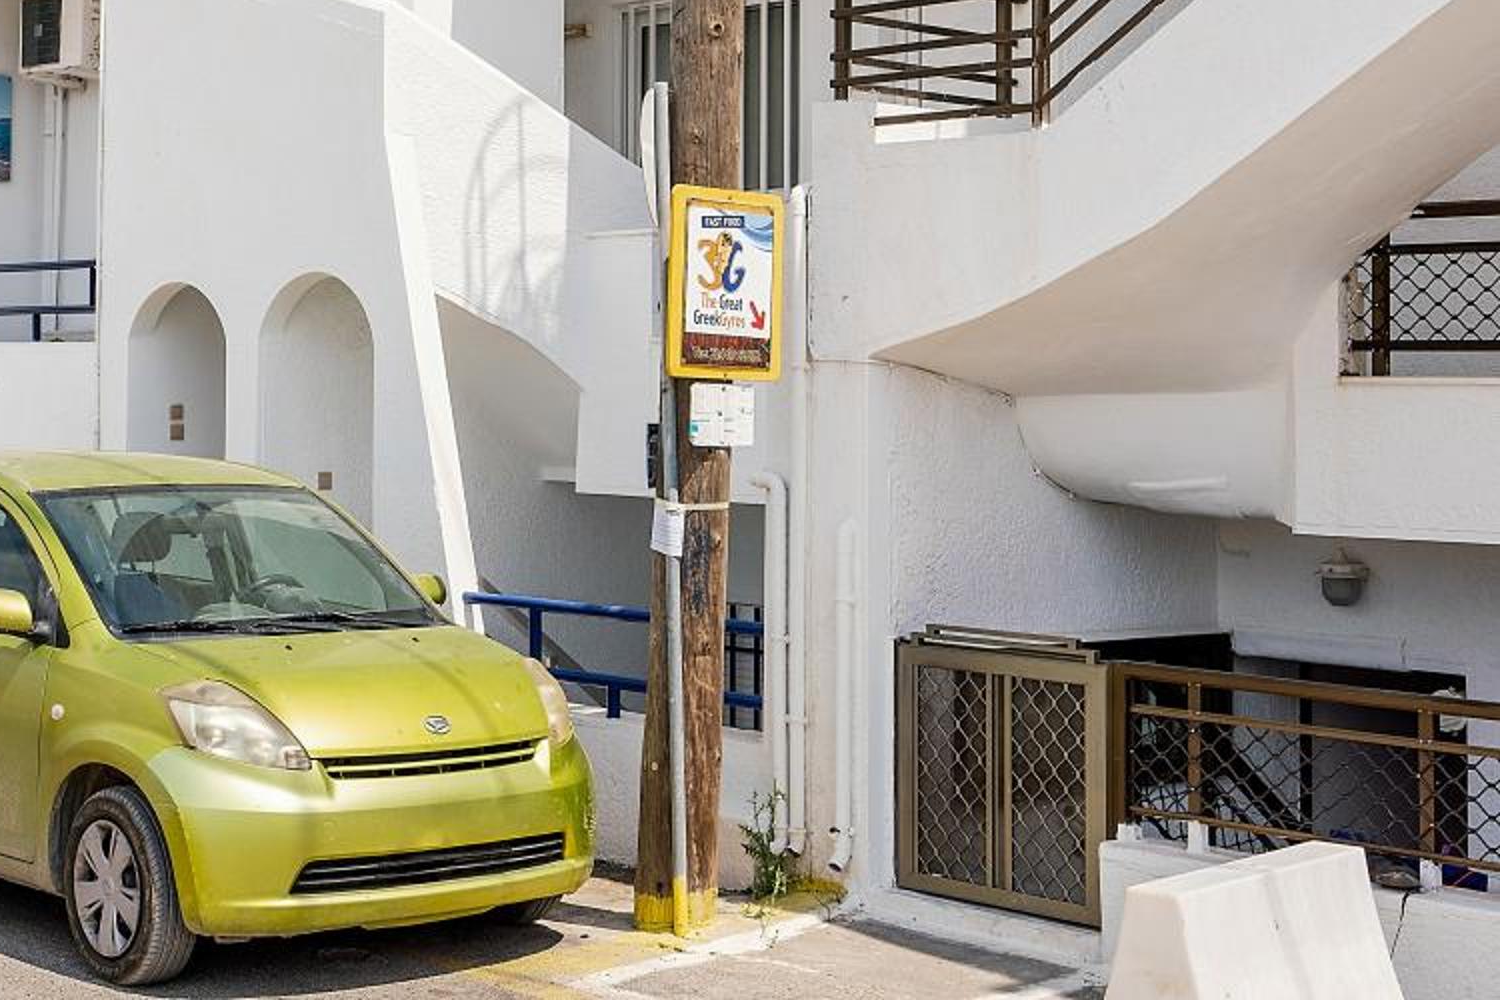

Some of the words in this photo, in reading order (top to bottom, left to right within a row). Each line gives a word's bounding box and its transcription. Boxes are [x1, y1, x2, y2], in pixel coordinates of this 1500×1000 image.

[704, 217, 722, 227] FAST
[723, 218, 743, 227] FOOD
[701, 291, 718, 309] The
[719, 294, 743, 311] Great
